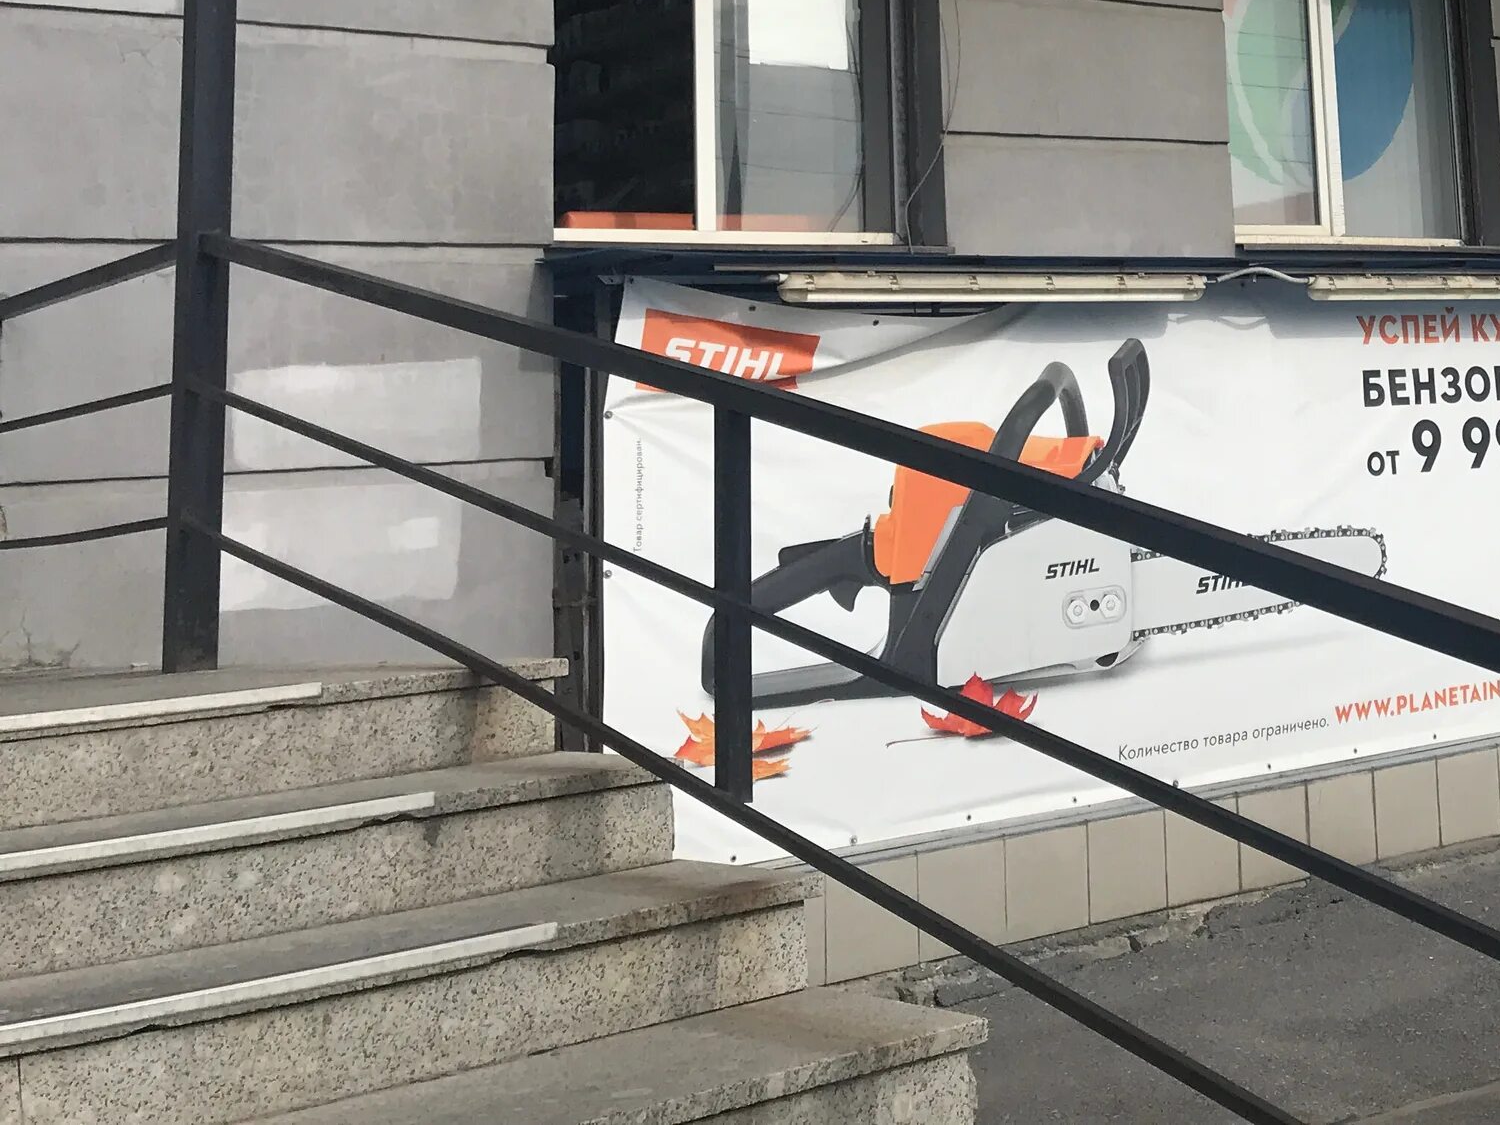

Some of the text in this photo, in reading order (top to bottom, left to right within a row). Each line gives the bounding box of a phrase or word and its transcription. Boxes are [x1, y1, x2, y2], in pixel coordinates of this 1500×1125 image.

[1356, 306, 1461, 345] УСПЕЙ
[665, 337, 792, 381] STIHL
[633, 437, 645, 552] Товар сертифицирован.
[1045, 558, 1100, 580] STIHL
[1195, 575, 1243, 594] STI
[1118, 717, 1330, 761] Количество товара ограничено.
